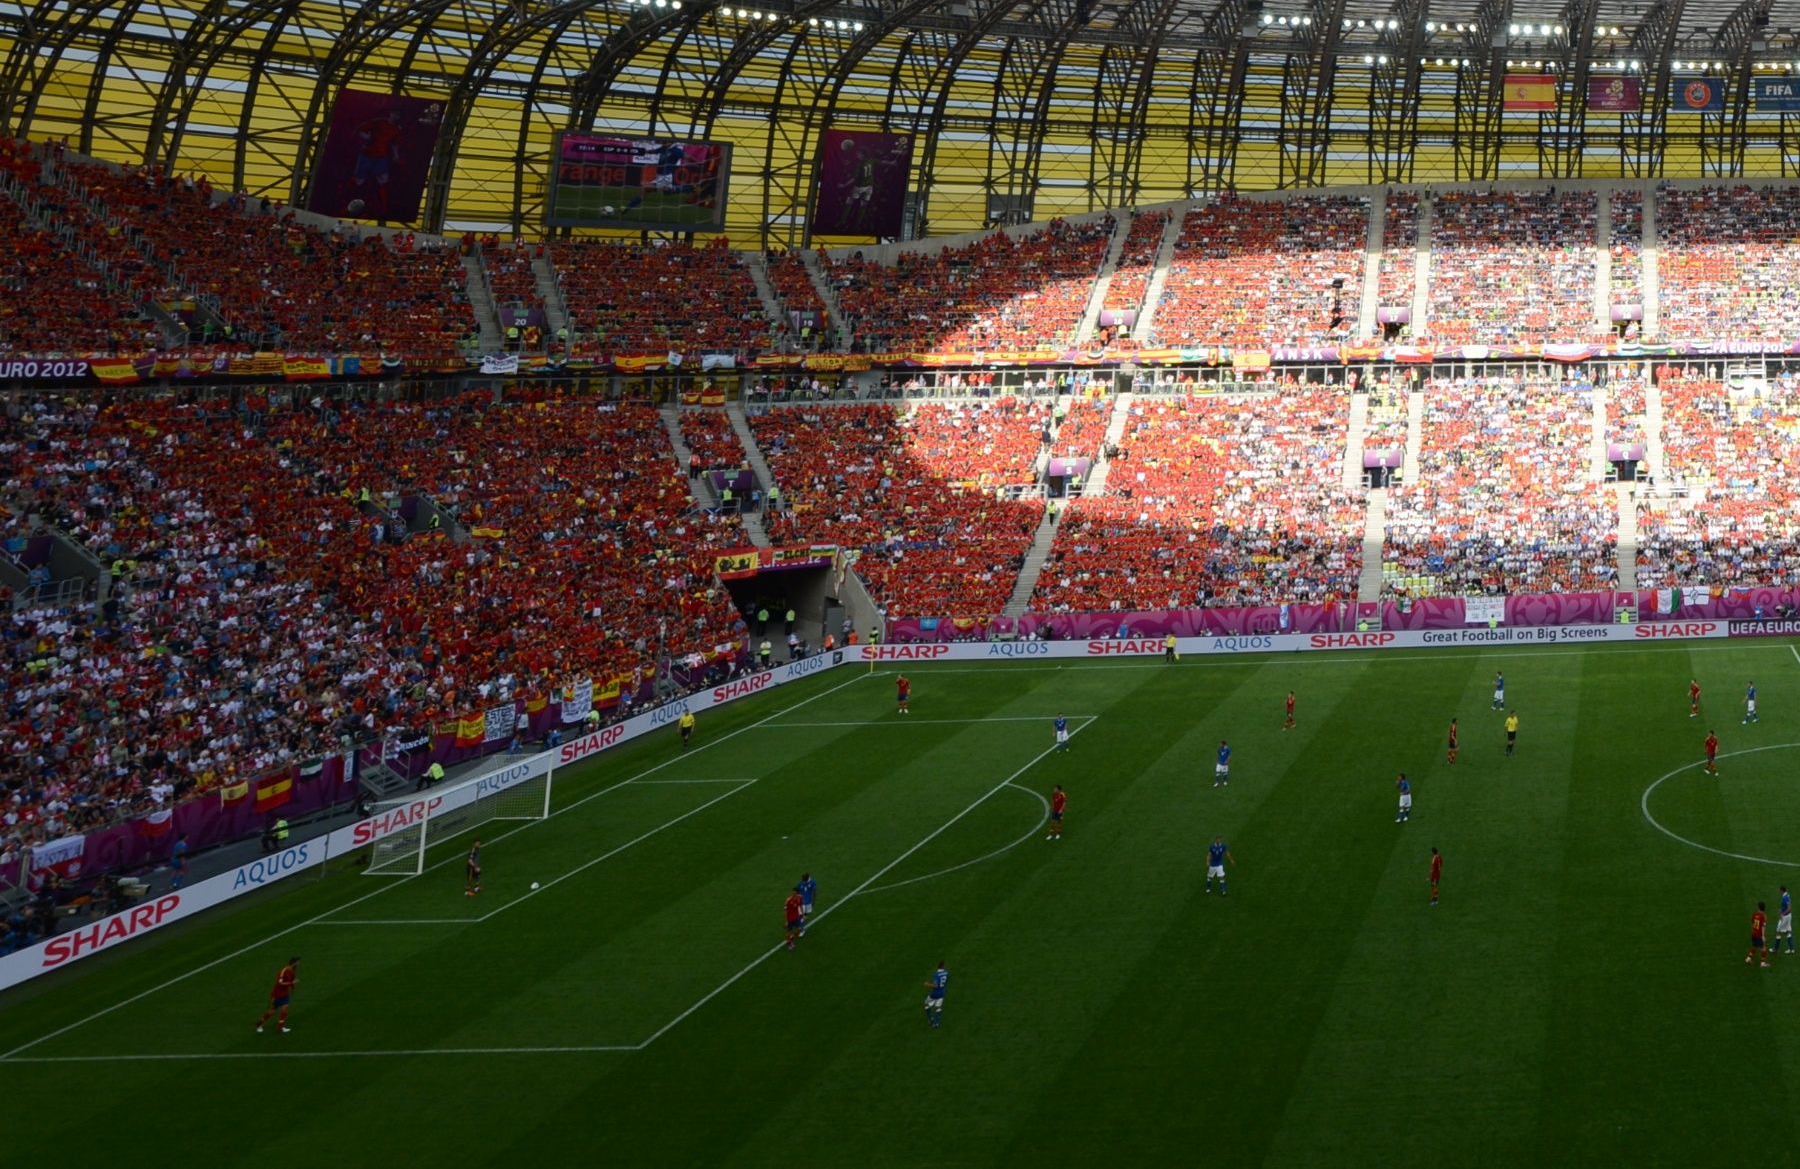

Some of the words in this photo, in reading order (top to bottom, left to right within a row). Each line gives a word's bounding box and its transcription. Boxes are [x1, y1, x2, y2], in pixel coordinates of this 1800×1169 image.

[1765, 85, 1793, 96] FIFA
[515, 318, 527, 326] 20
[1730, 342, 1760, 353] EURO
[41, 362, 88, 377] 2012
[1423, 631, 1458, 643] Great
[1462, 629, 1513, 641] Football
[1517, 631, 1533, 639] on
[1538, 628, 1557, 642] Big
[1561, 627, 1608, 639] Screens
[1635, 622, 1717, 637] SHARP
[1731, 622, 1766, 635] UEFA
[989, 641, 1048, 656] AQUOS
[1213, 636, 1272, 650] AQUOS
[1311, 633, 1395, 648] SHARP
[861, 644, 949, 660] SHARP
[788, 655, 823, 677] AQUOS
[713, 672, 772, 703] SHARP
[650, 699, 688, 725] AQUOS
[561, 725, 624, 763] SHARP
[478, 763, 529, 792] AQUOS
[353, 797, 442, 845] SHARP
[233, 844, 308, 890] AQUOS
[42, 894, 180, 967] SHARP
